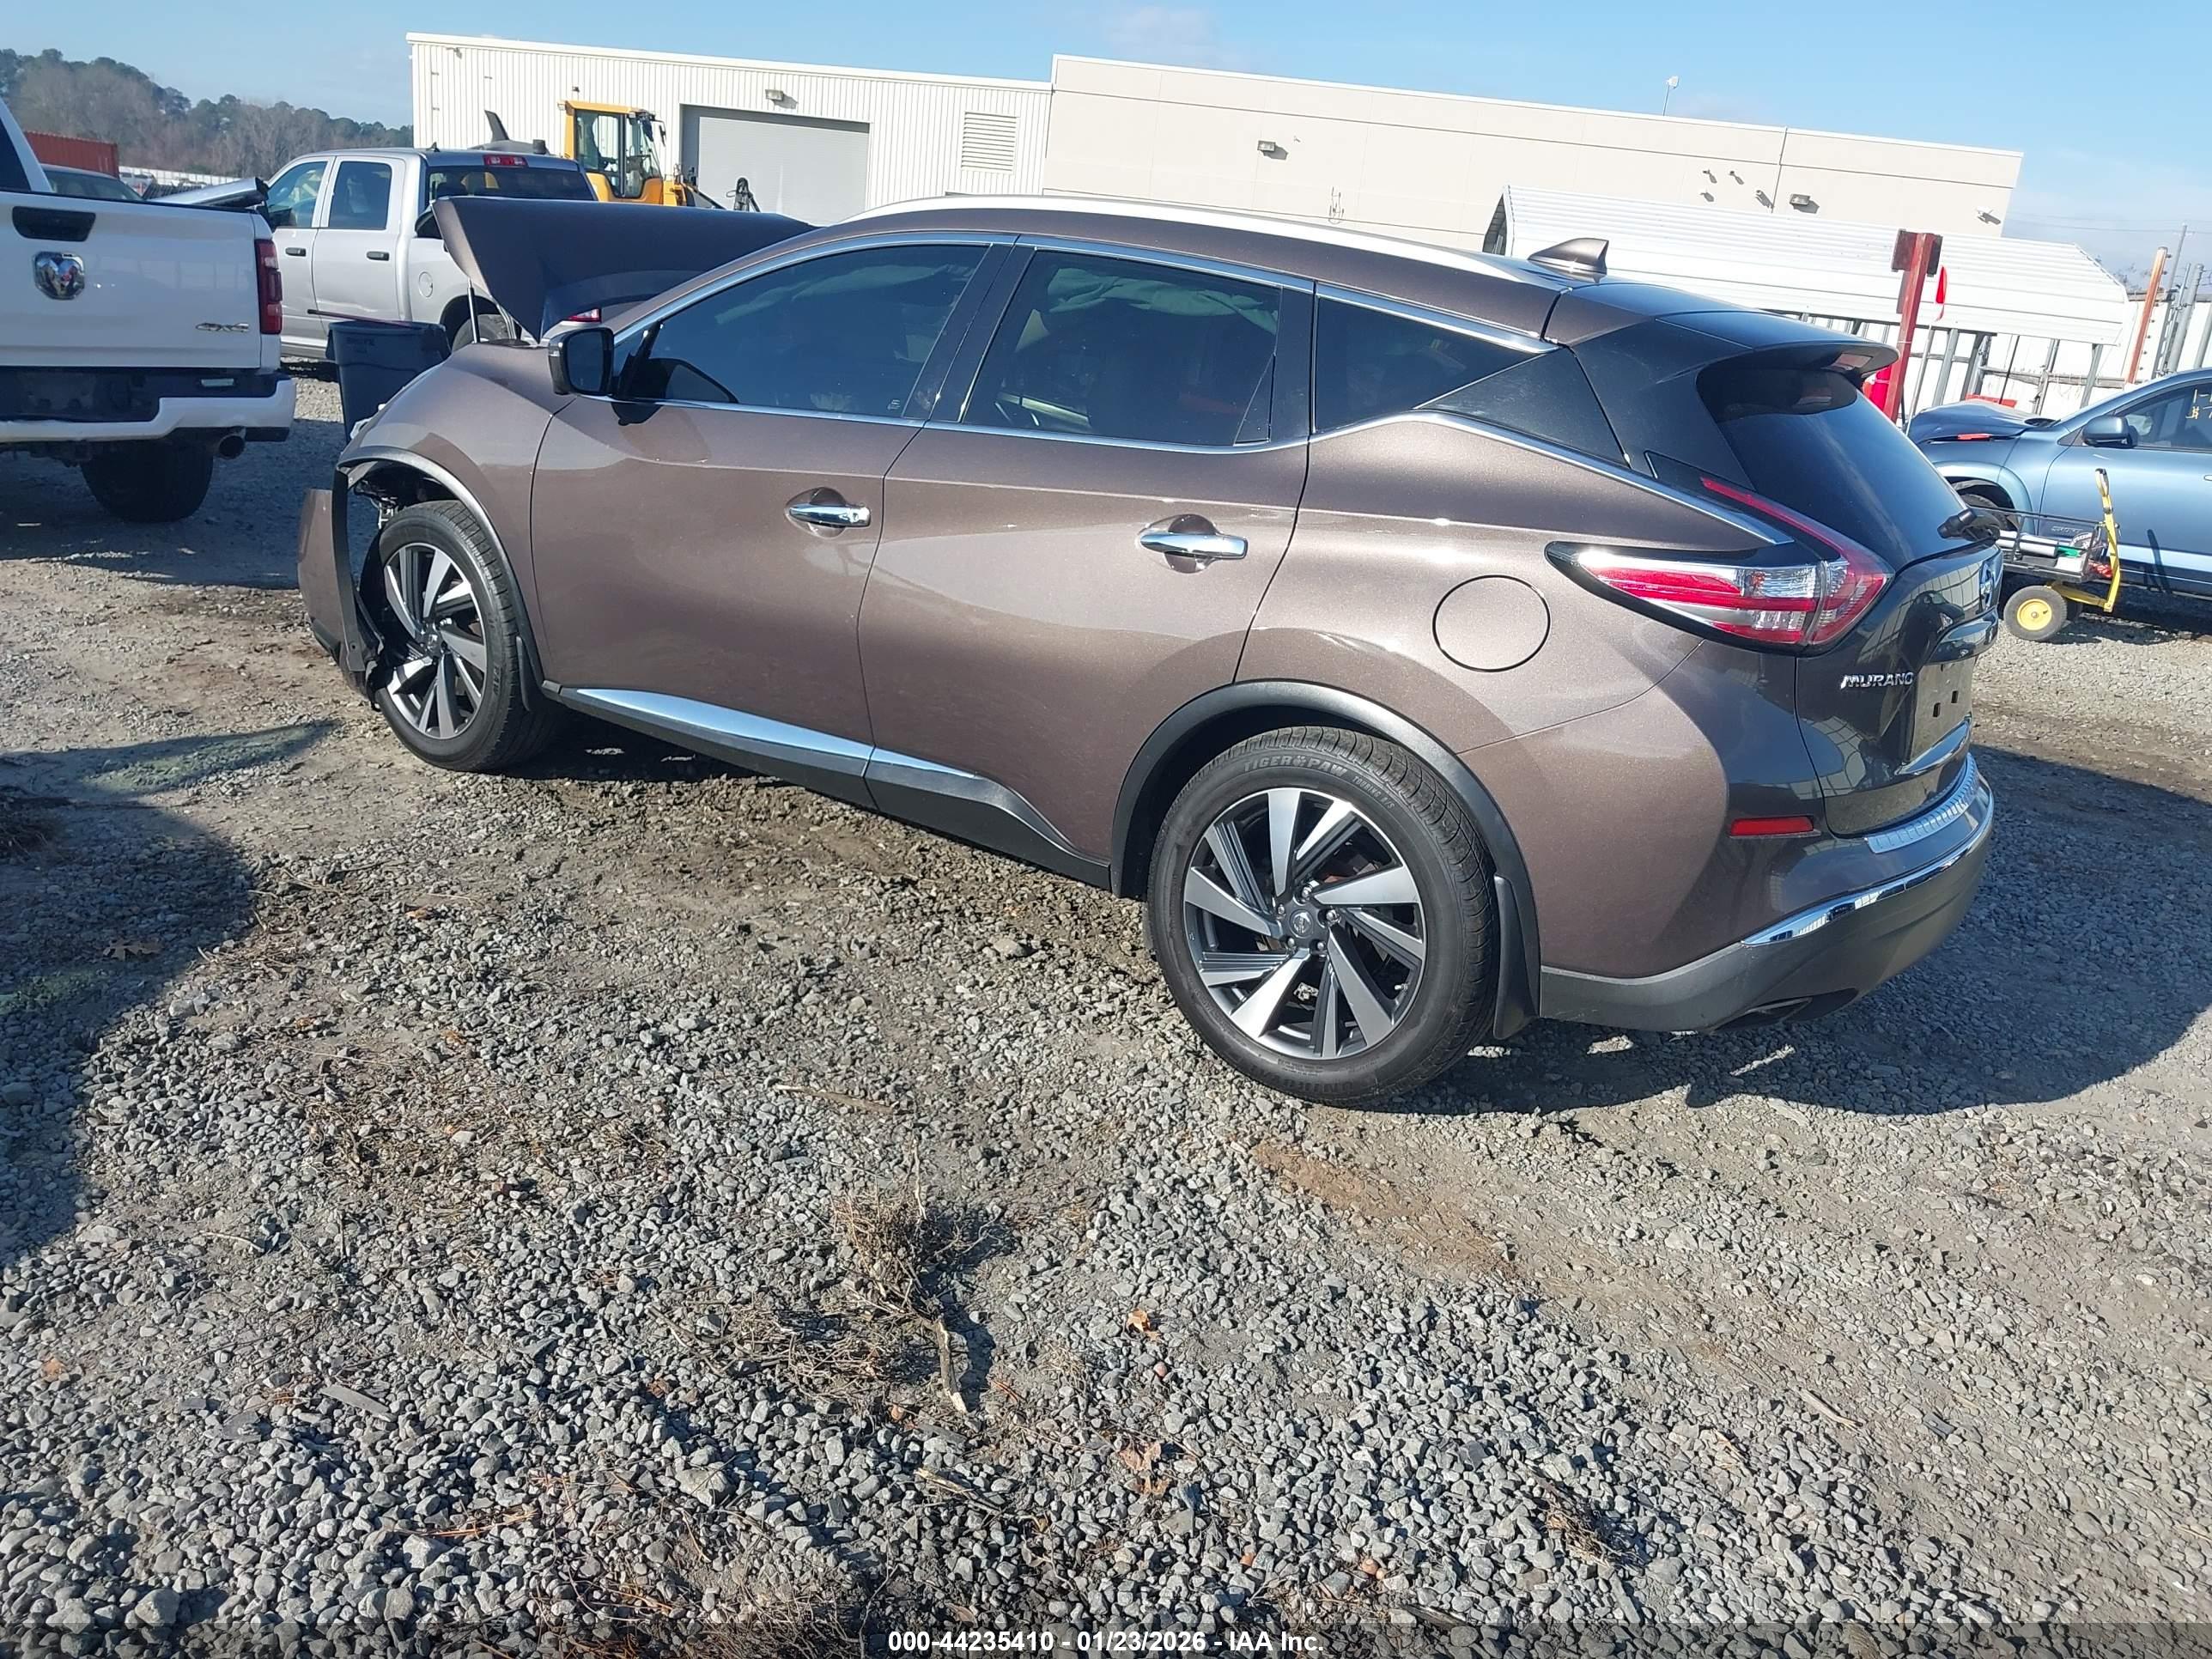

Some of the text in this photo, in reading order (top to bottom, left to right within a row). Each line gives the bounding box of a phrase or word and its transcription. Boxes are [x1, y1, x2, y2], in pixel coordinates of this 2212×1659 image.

[1840, 672, 1914, 690] MURANO
[1244, 755, 1348, 777] TIGER PAW
[1352, 775, 1382, 798] TOURING
